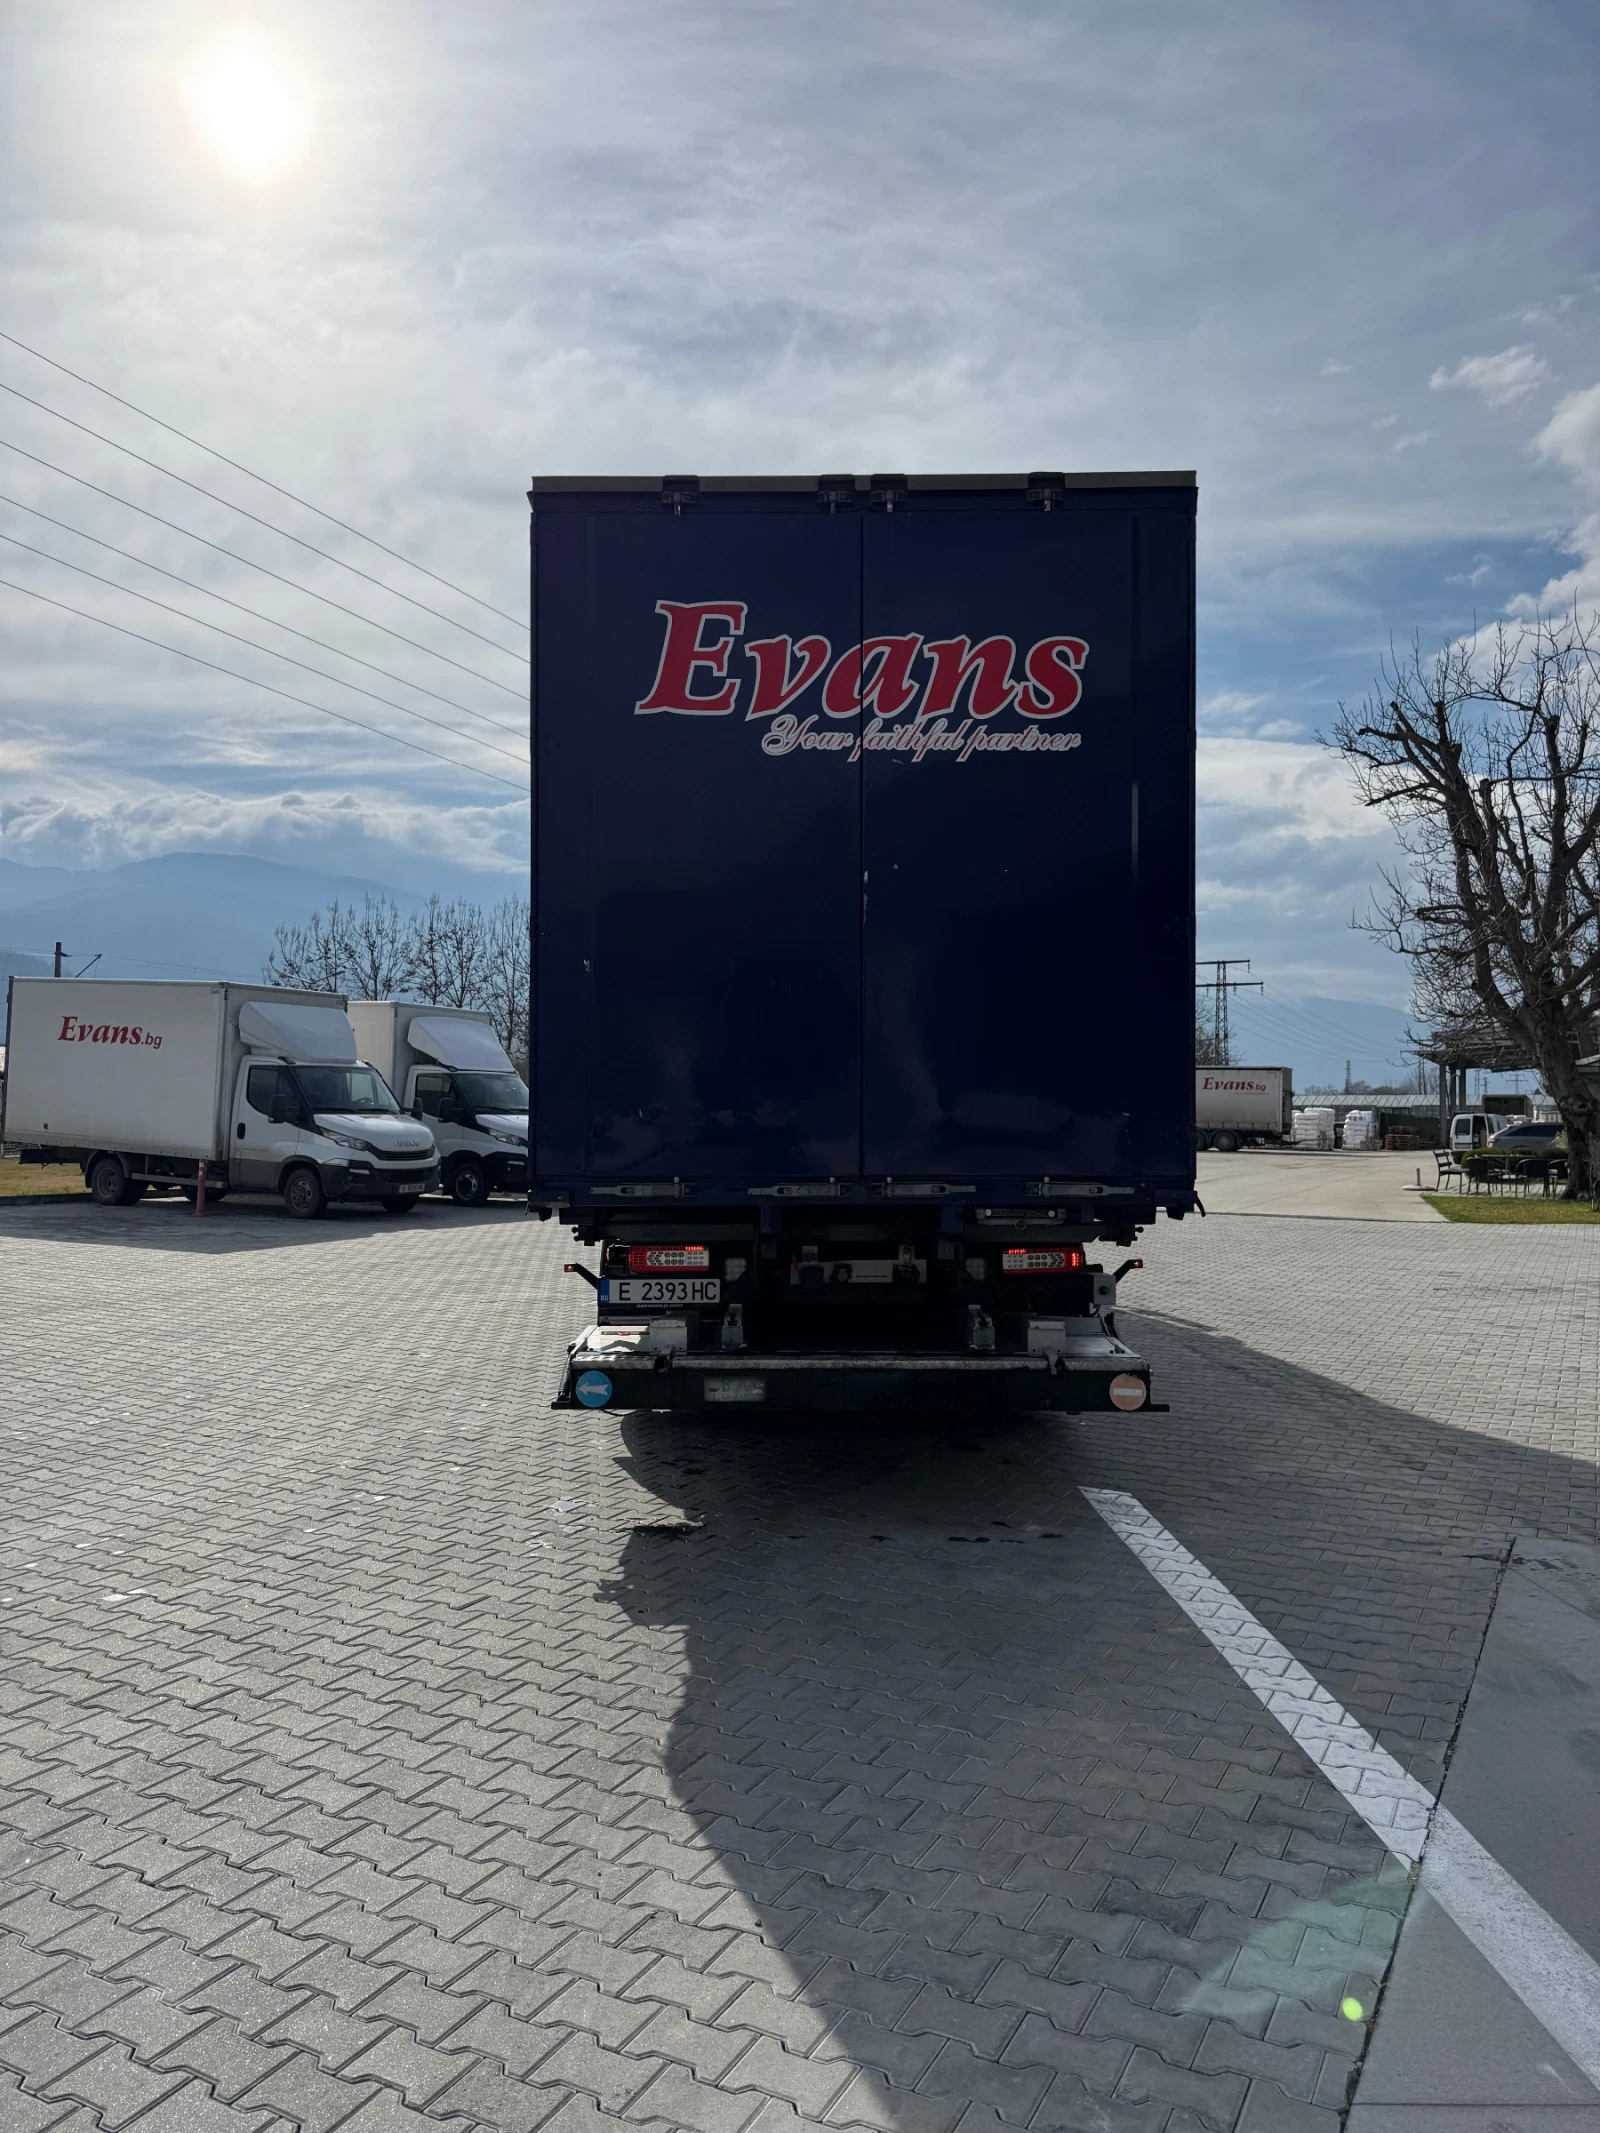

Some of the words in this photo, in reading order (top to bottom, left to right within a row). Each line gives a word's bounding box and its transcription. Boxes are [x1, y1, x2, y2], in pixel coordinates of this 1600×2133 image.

[634, 599, 1090, 722] Evans
[761, 713, 853, 756] Your
[847, 717, 974, 763] faithful
[955, 724, 1082, 763] partner
[57, 1015, 163, 1050] Evans.bg
[1202, 1077, 1266, 1092] Evans.bg
[619, 1282, 631, 1301] E
